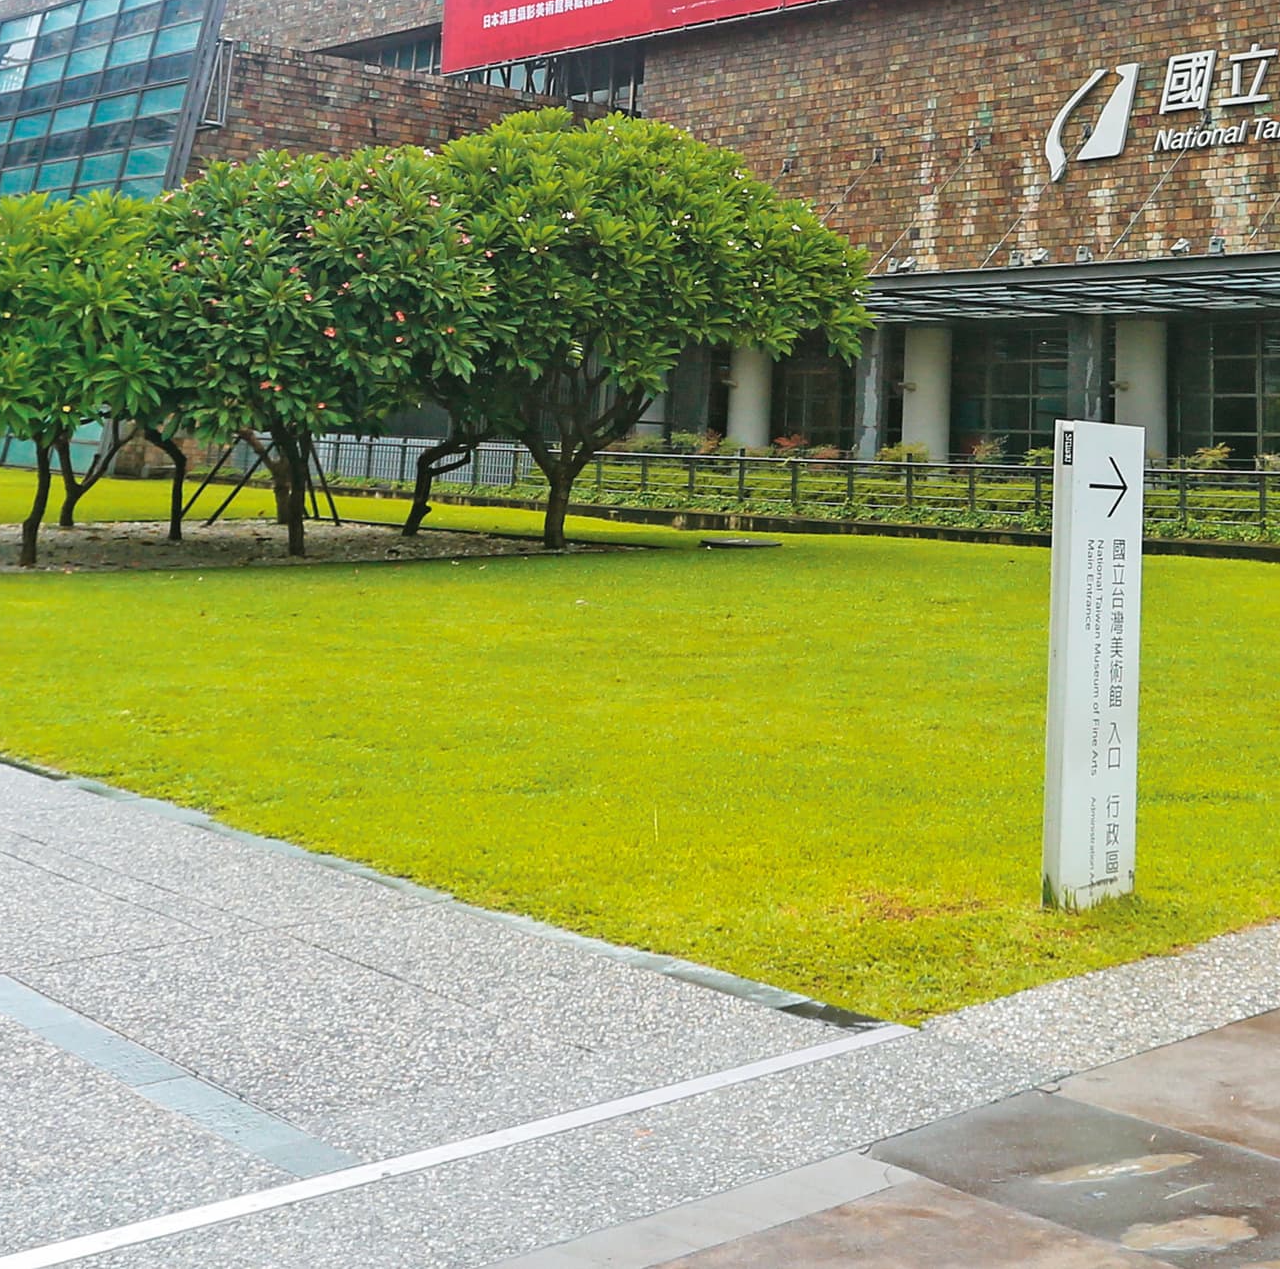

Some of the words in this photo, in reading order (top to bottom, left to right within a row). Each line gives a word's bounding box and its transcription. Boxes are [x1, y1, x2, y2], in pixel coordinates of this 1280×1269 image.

[1153, 119, 1249, 152] National
[1087, 539, 1095, 567] Main
[1096, 539, 1104, 591] National
[1085, 573, 1094, 631] Entrance
[1094, 595, 1103, 639] Taiwan
[1109, 539, 1126, 708] 國立台灣美術館
[1093, 643, 1102, 699] Museum
[1092, 703, 1100, 715] of
[1092, 718, 1100, 747] Fine
[1108, 721, 1121, 769] 入口
[1091, 749, 1099, 776] Arts
[1105, 794, 1120, 874] 行政區
